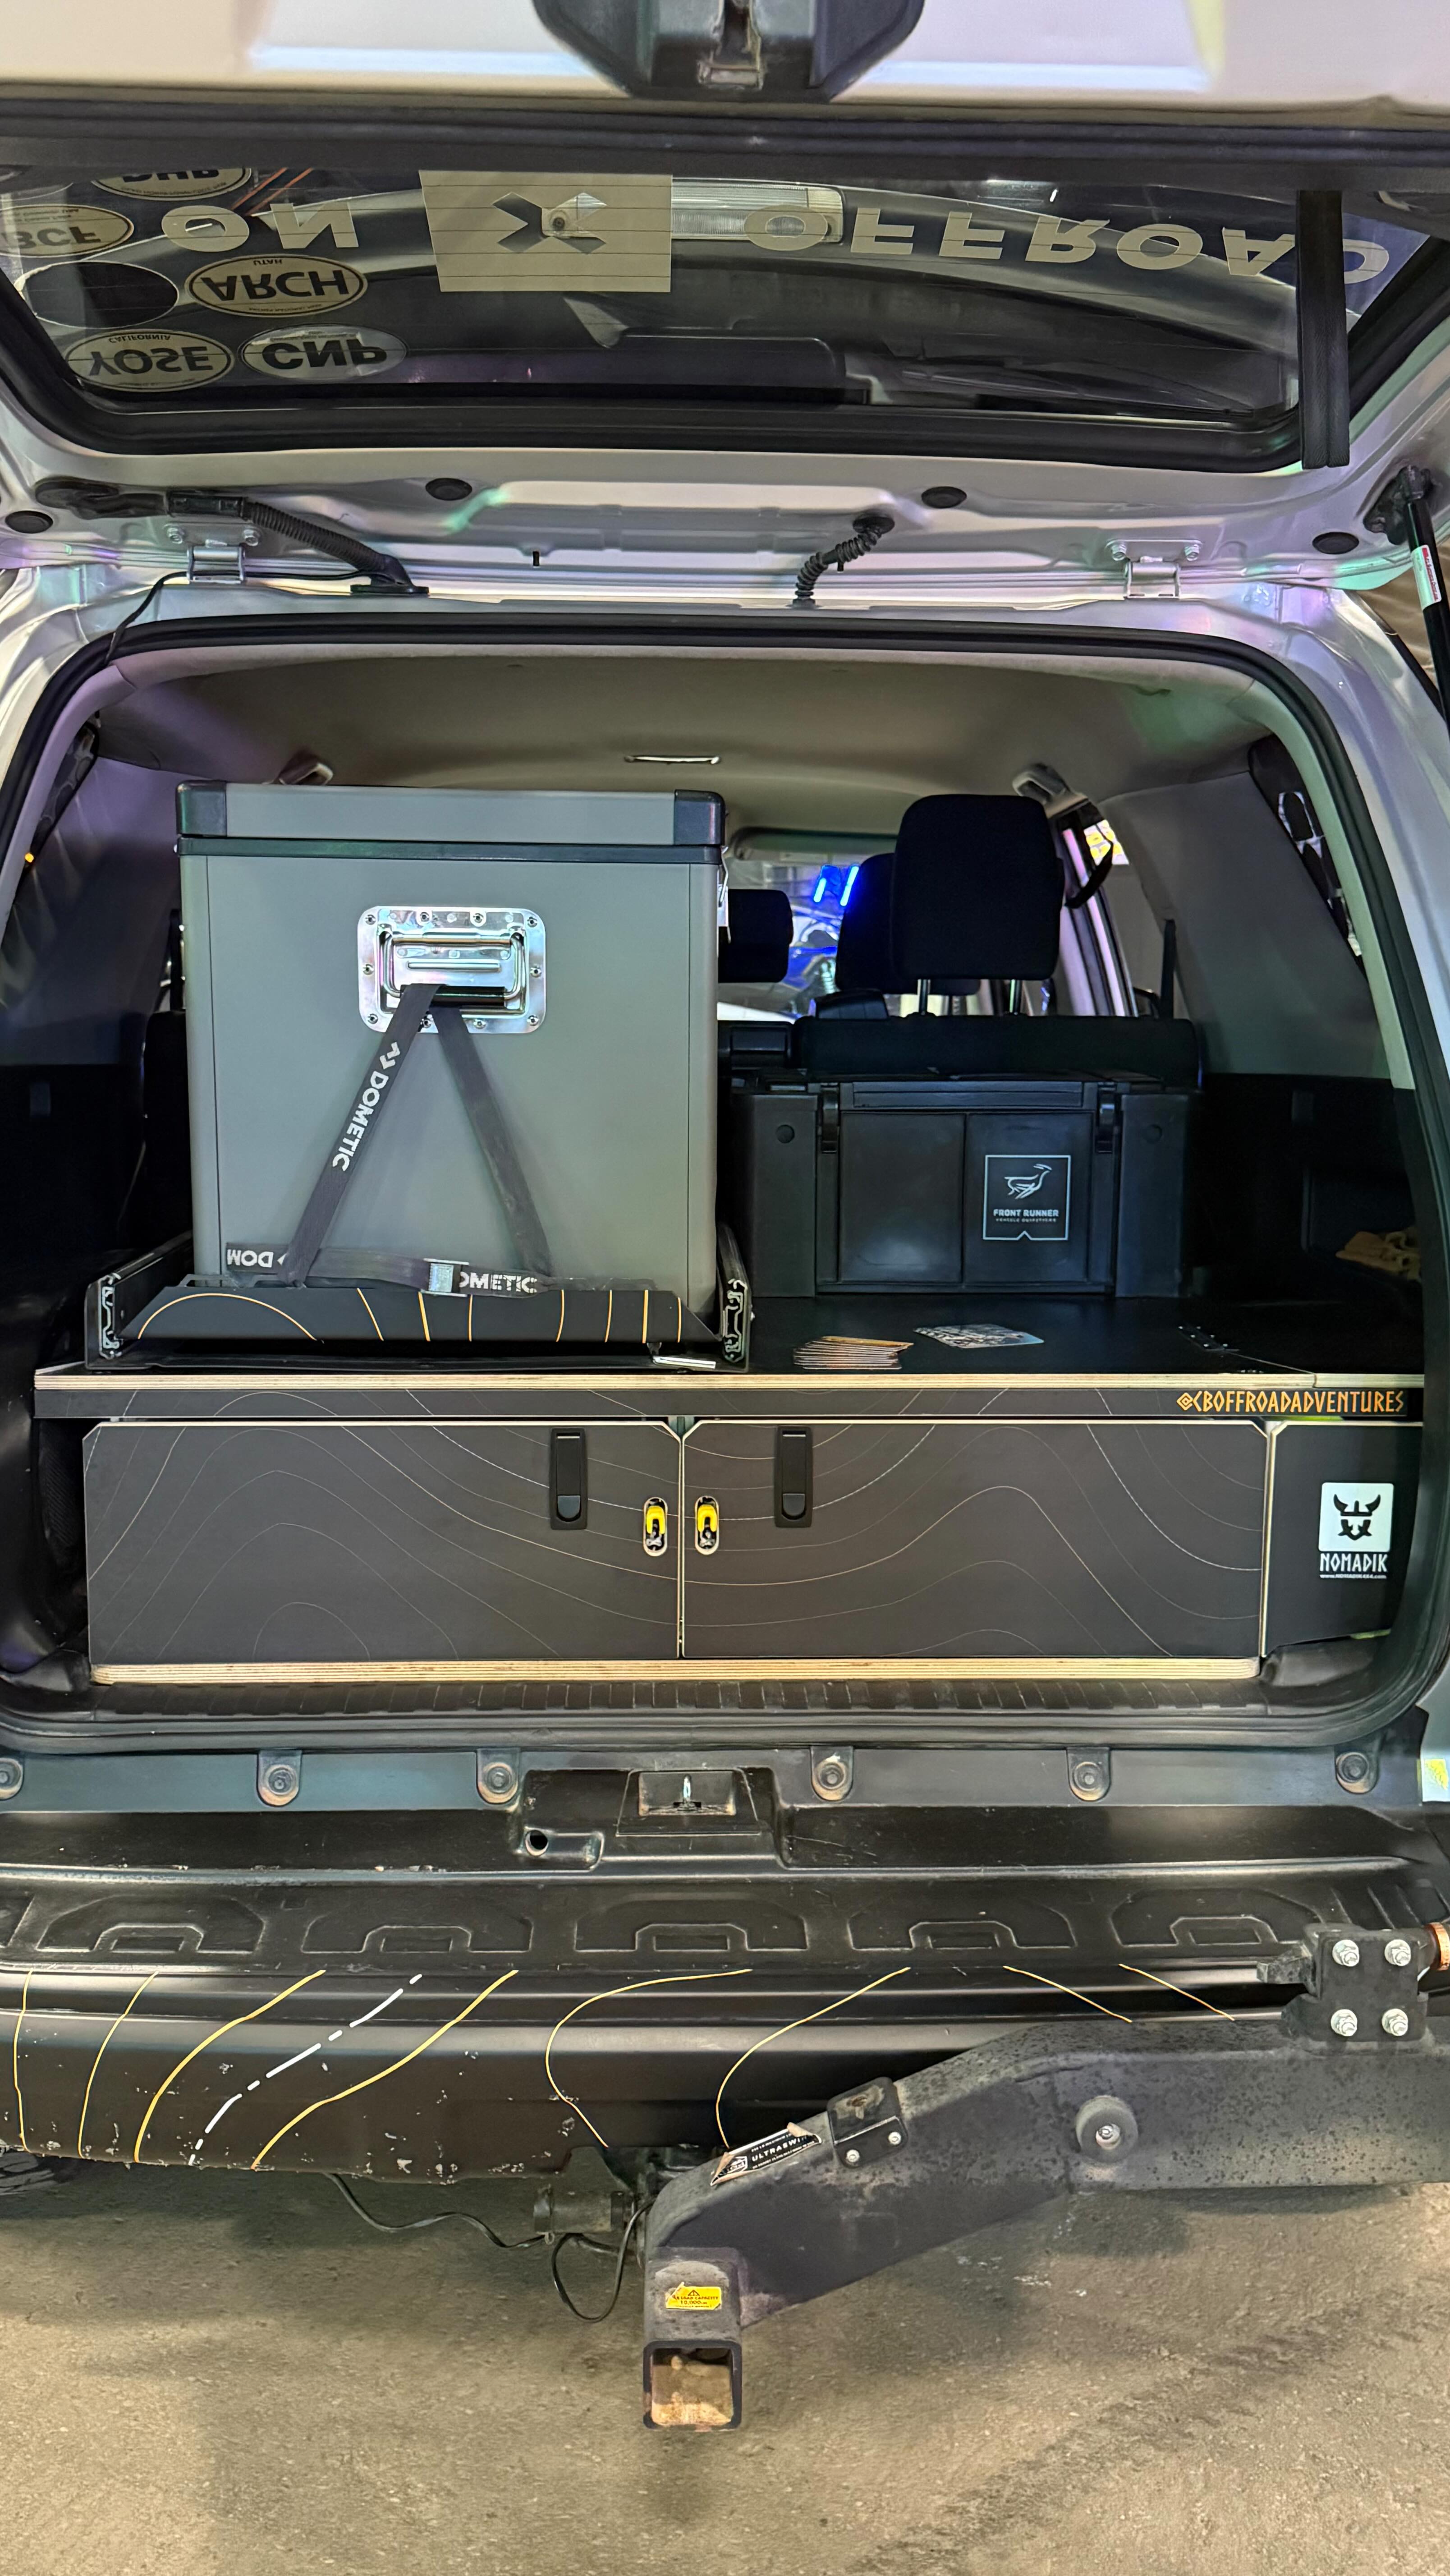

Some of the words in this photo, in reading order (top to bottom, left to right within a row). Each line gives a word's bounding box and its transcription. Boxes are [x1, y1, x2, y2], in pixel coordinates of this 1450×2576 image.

[331, 1070, 389, 1172] DOMETIC
[993, 1209, 1021, 1217] FRONT
[1023, 1209, 1059, 1217] RUNNER
[1176, 1390, 1404, 1413] @CBOFFROADADVENTURES
[1320, 1553, 1388, 1572] NOMADIK
